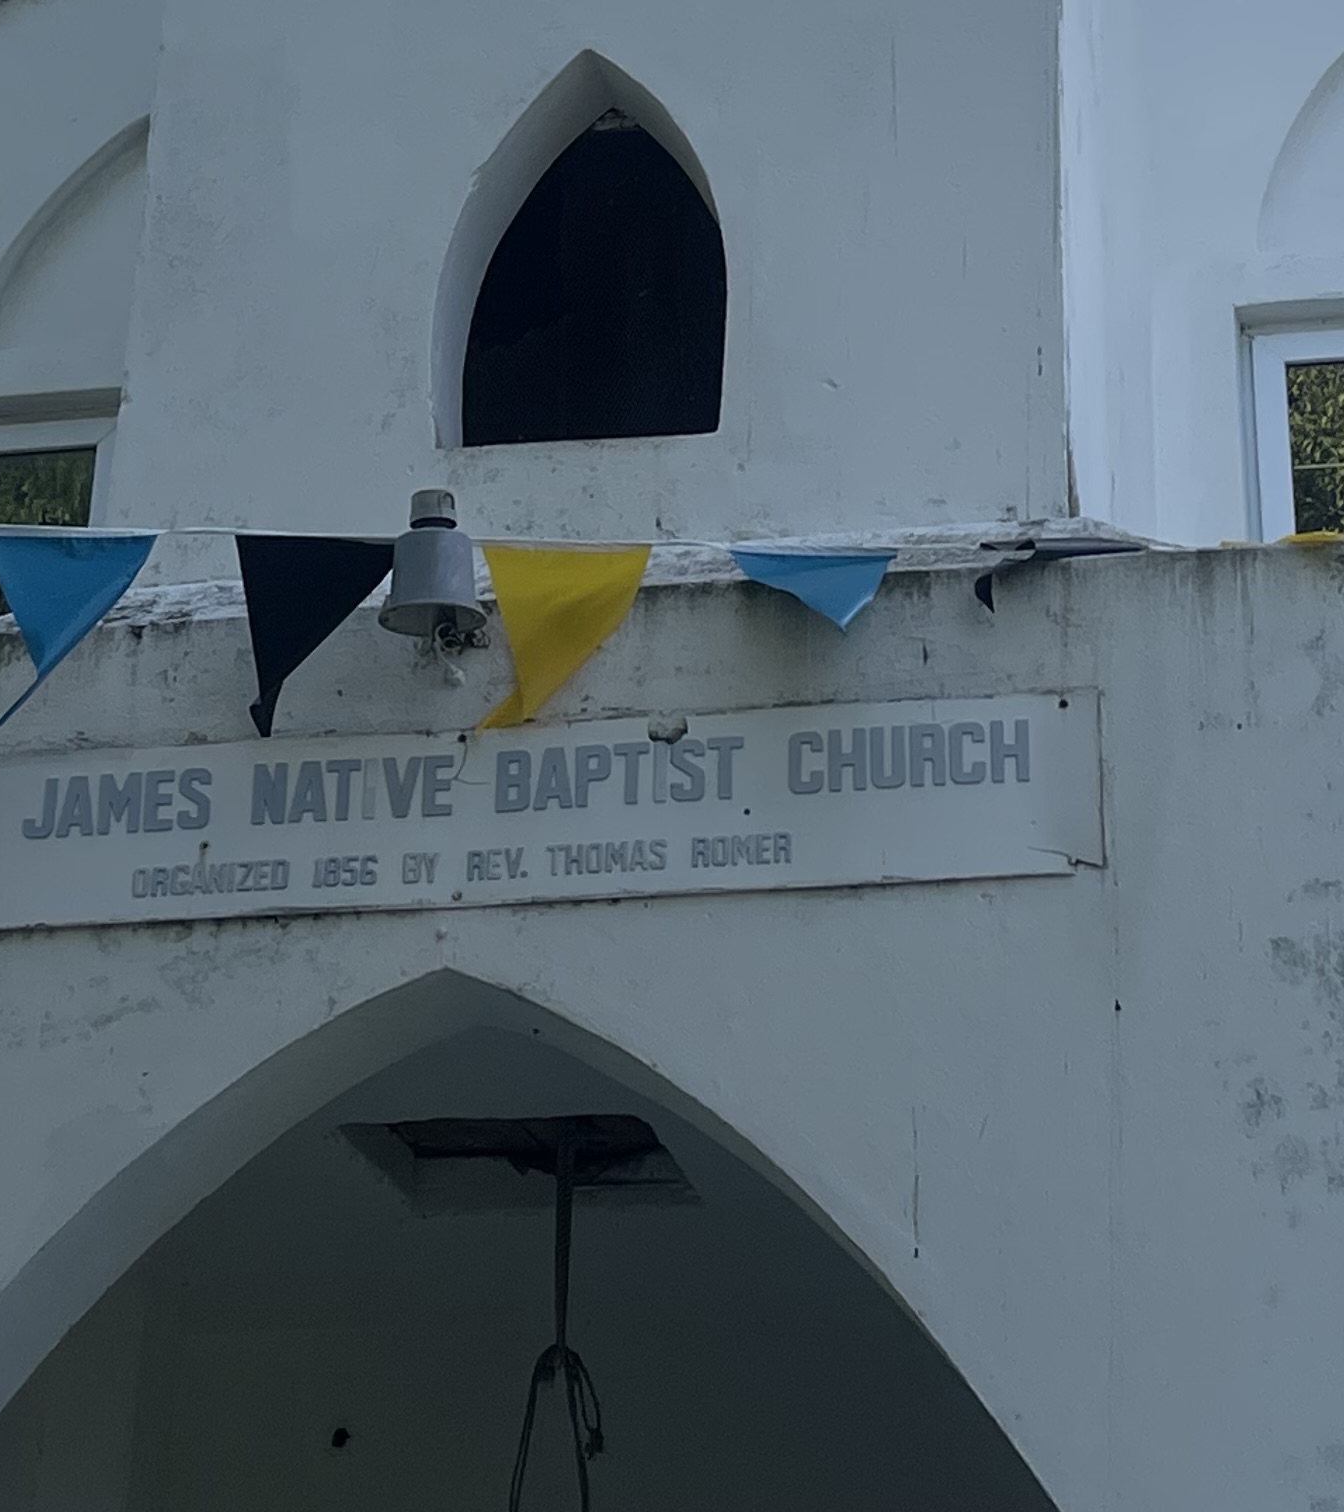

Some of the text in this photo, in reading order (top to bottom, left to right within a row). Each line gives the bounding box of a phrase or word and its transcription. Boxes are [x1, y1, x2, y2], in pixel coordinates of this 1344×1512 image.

[22, 768, 212, 840] JAMES
[250, 755, 454, 825] NATIVE
[495, 736, 744, 813] BAPTIST
[788, 719, 1031, 795] CHURCH
[132, 831, 792, 899] ORGANIZED 1856 BY REV. THOMAS ROMER
